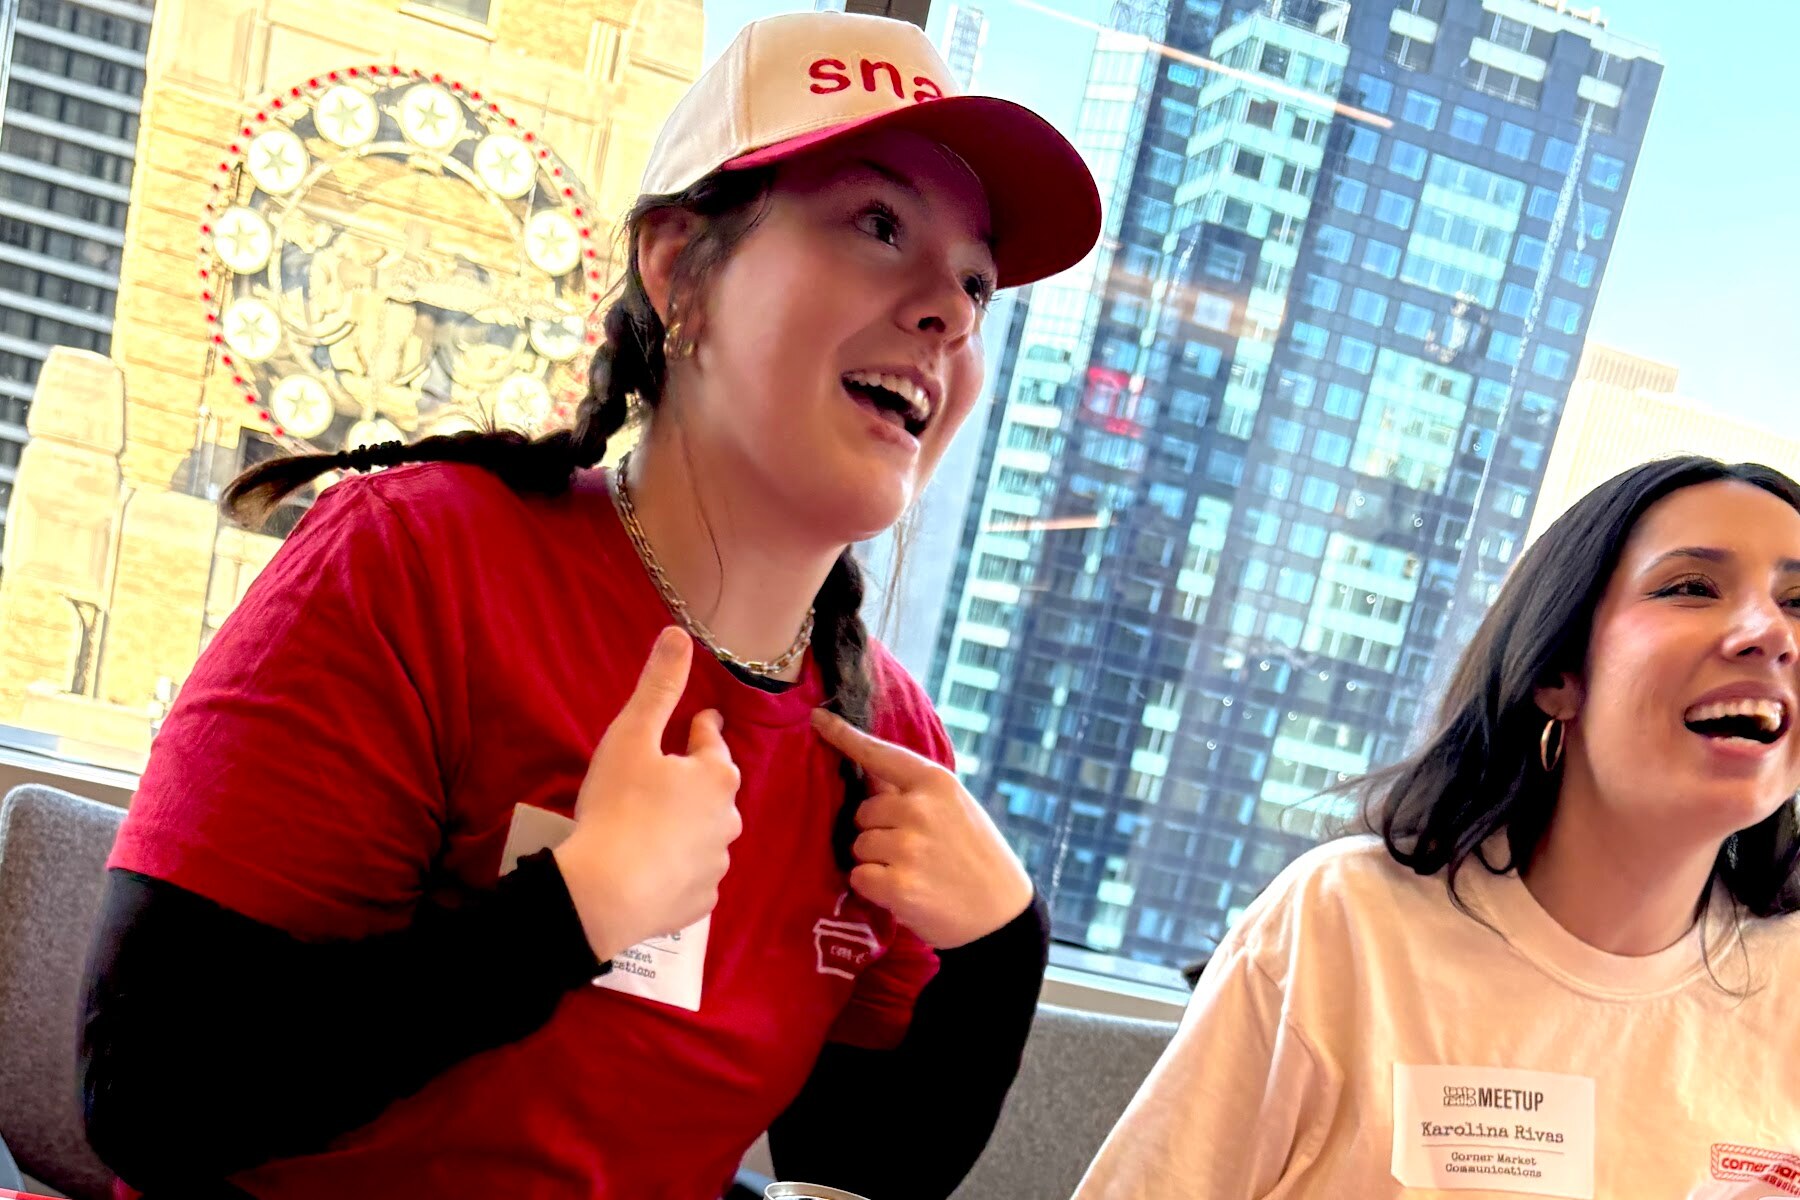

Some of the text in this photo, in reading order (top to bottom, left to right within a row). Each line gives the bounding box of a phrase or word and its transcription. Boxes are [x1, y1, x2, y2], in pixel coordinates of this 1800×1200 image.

[622, 947, 653, 964] arket
[1478, 1087, 1544, 1112] MEETUP
[1421, 1121, 1564, 1143] Karolina Rivas
[1451, 1151, 1537, 1166] Corner Market
[1721, 1157, 1770, 1173] corner
[1445, 1163, 1542, 1178] Communications
